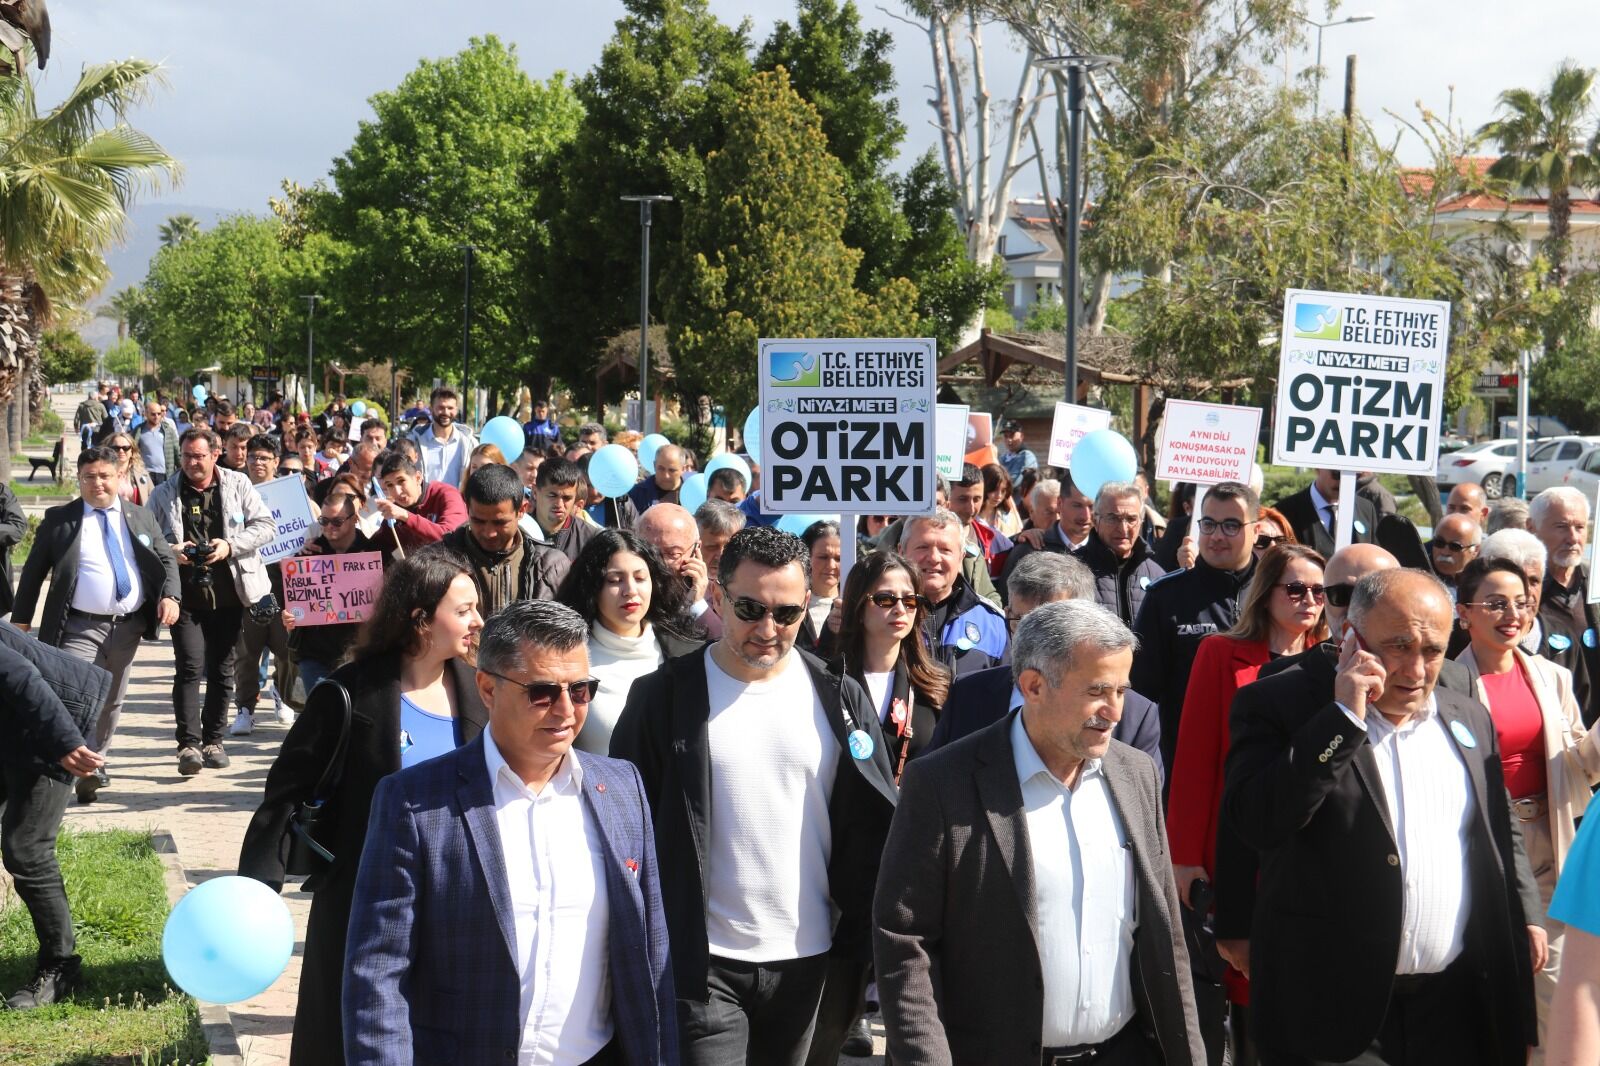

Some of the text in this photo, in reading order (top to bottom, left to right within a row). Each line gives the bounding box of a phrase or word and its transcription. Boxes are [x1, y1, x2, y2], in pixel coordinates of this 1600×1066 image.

[1345, 307, 1369, 325] T.C.
[822, 352, 850, 369] T.C.
[1367, 355, 1408, 372] METE
[852, 399, 895, 413] METE
[1189, 430, 1212, 439] AYNI
[1286, 416, 1428, 461] PARKI
[1169, 442, 1246, 456] KONUŞMASAK DA
[1173, 454, 1239, 467] AYNI DUYGUYU
[773, 465, 924, 501] PARKI
[278, 517, 308, 535] DEĞİL
[259, 536, 305, 557] KLILIKTIR
[343, 561, 366, 572] FARK
[285, 576, 317, 588] KABUL
[325, 610, 363, 623] MOLA
